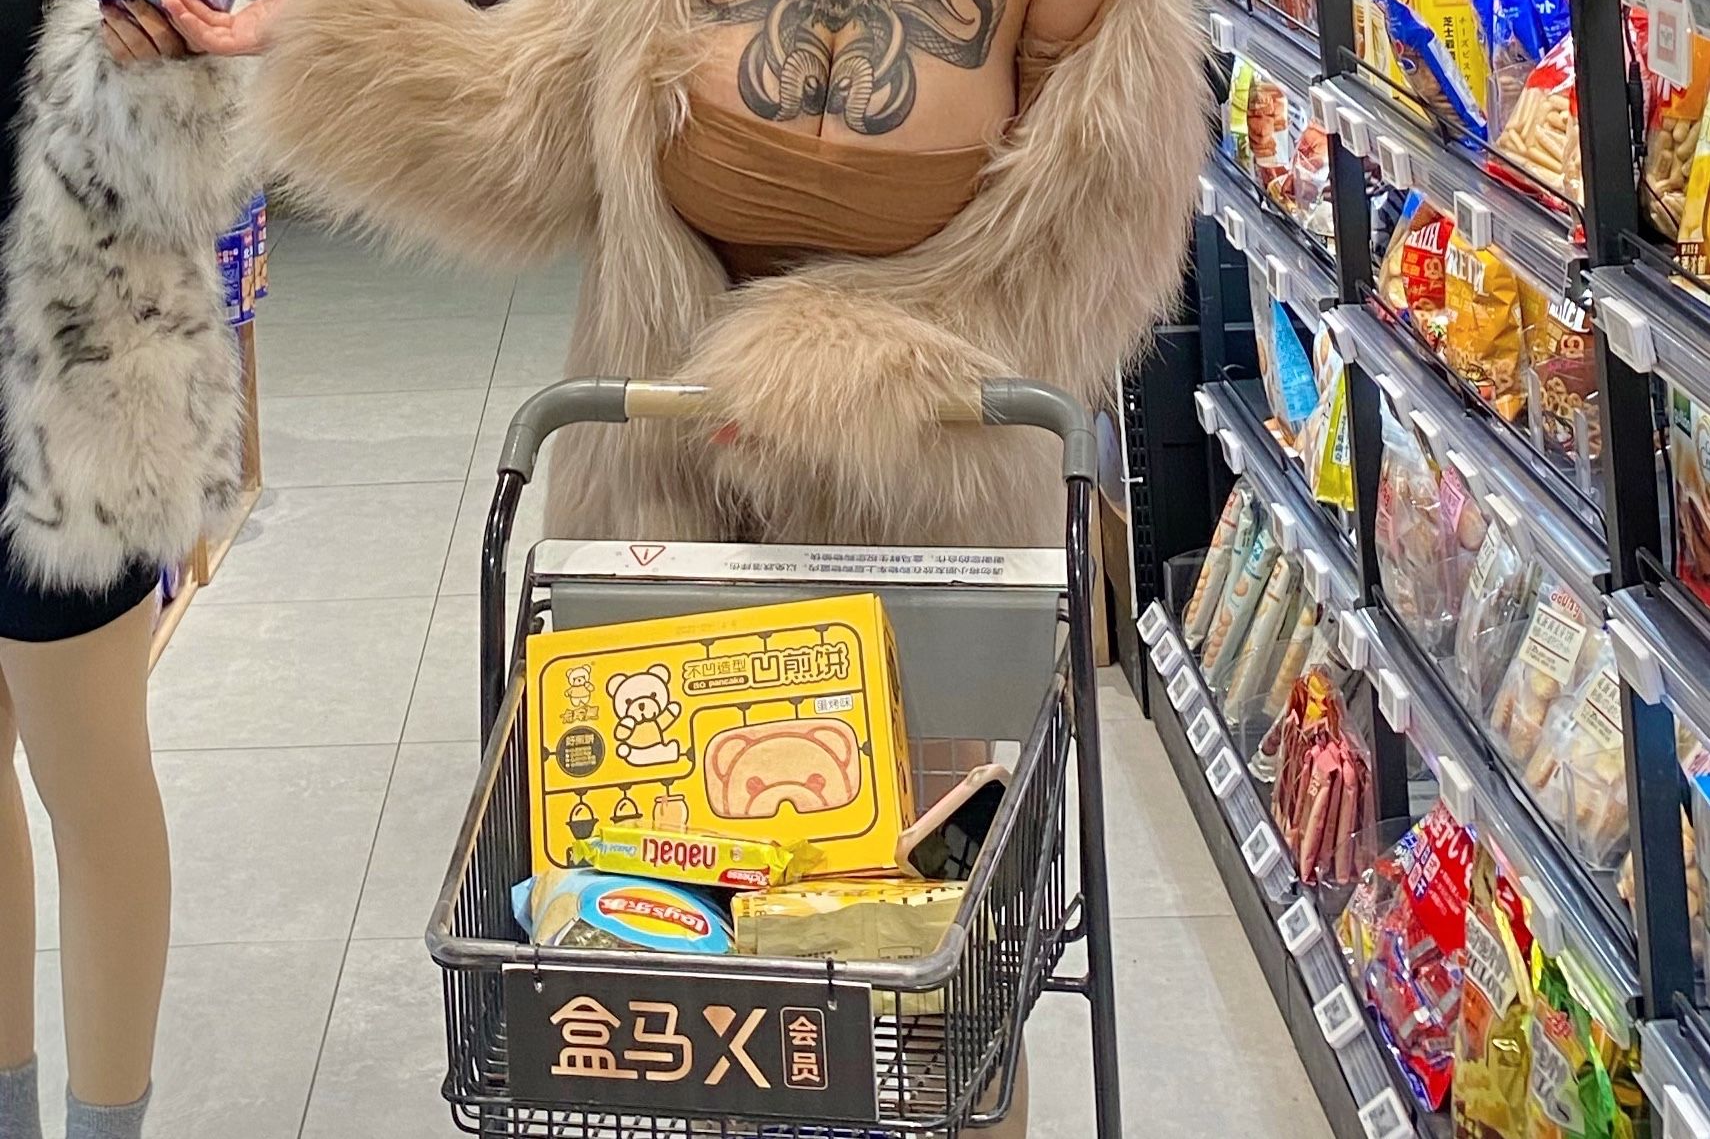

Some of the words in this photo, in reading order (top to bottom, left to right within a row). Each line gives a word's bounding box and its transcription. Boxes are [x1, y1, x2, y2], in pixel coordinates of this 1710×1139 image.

[686, 658, 747, 680] 不凹造型
[752, 644, 849, 688] 凹煎饼
[642, 838, 717, 871] nabati
[787, 1015, 822, 1083] 会员
